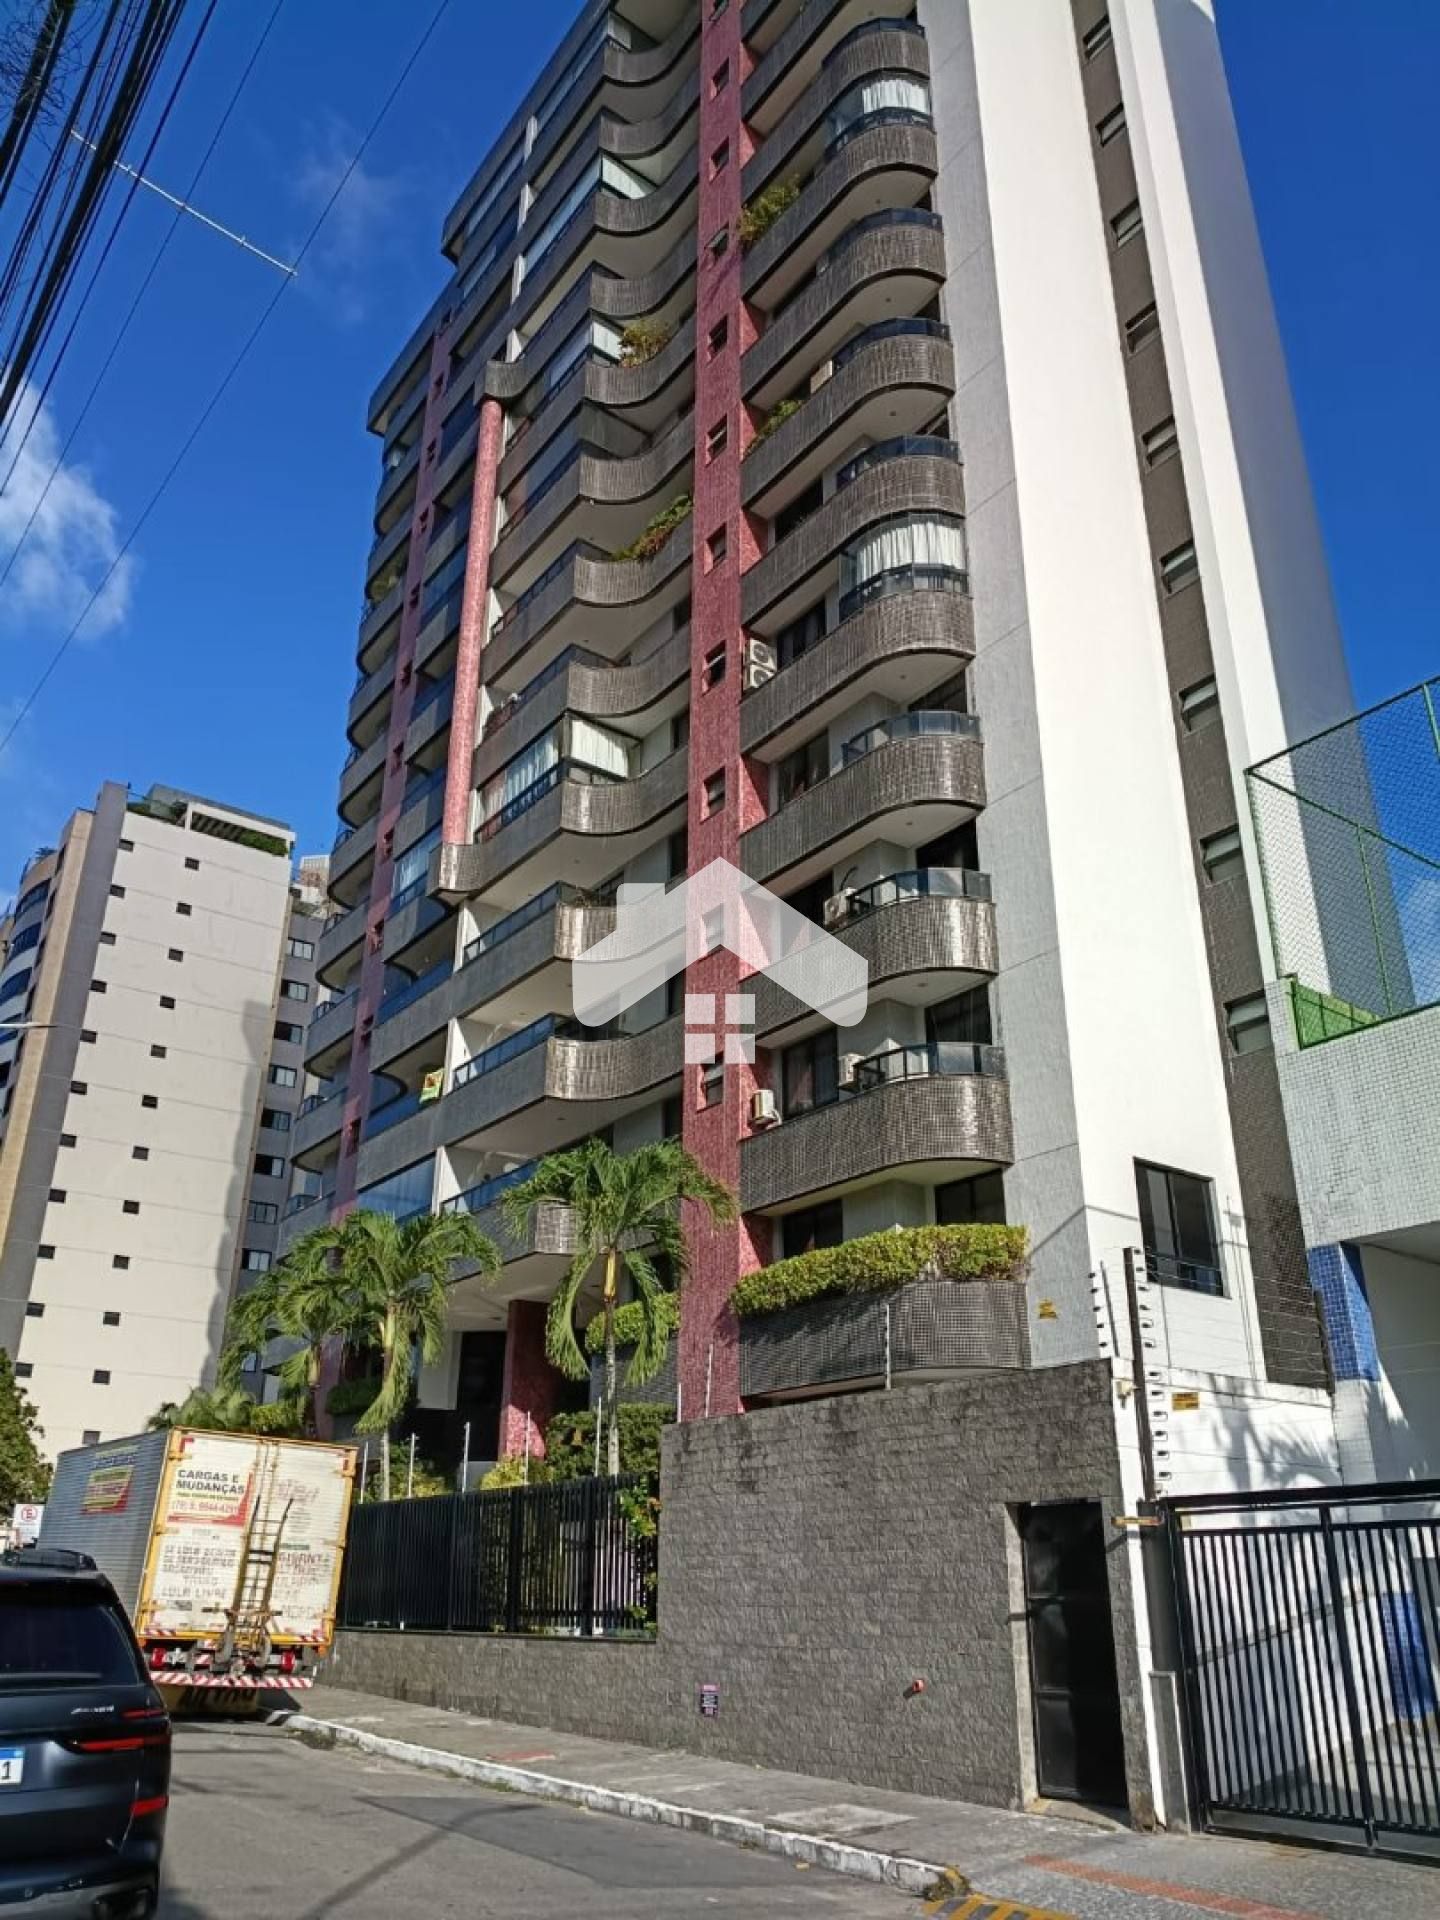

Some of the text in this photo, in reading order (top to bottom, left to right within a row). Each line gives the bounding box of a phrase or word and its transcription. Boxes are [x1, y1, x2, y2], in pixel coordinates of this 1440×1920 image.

[178, 1470, 239, 1483] CARGAS E
[176, 1480, 245, 1494] MUDANÇAS
